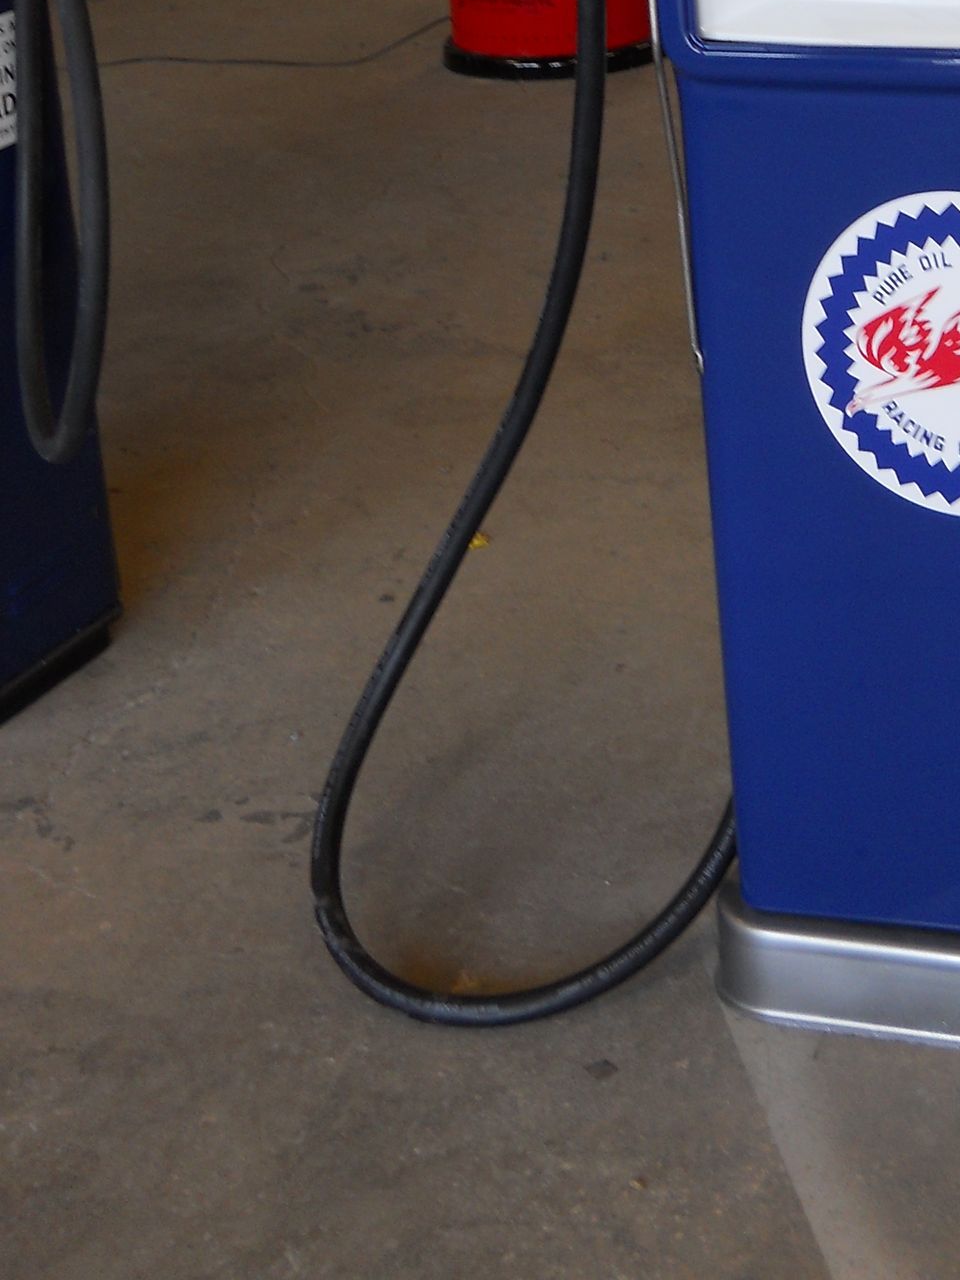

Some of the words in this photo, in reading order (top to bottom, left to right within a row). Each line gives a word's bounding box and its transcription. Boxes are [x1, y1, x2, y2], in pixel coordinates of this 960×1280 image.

[871, 263, 914, 306] PURE
[920, 251, 952, 271] OIL
[882, 400, 946, 452] RACING
